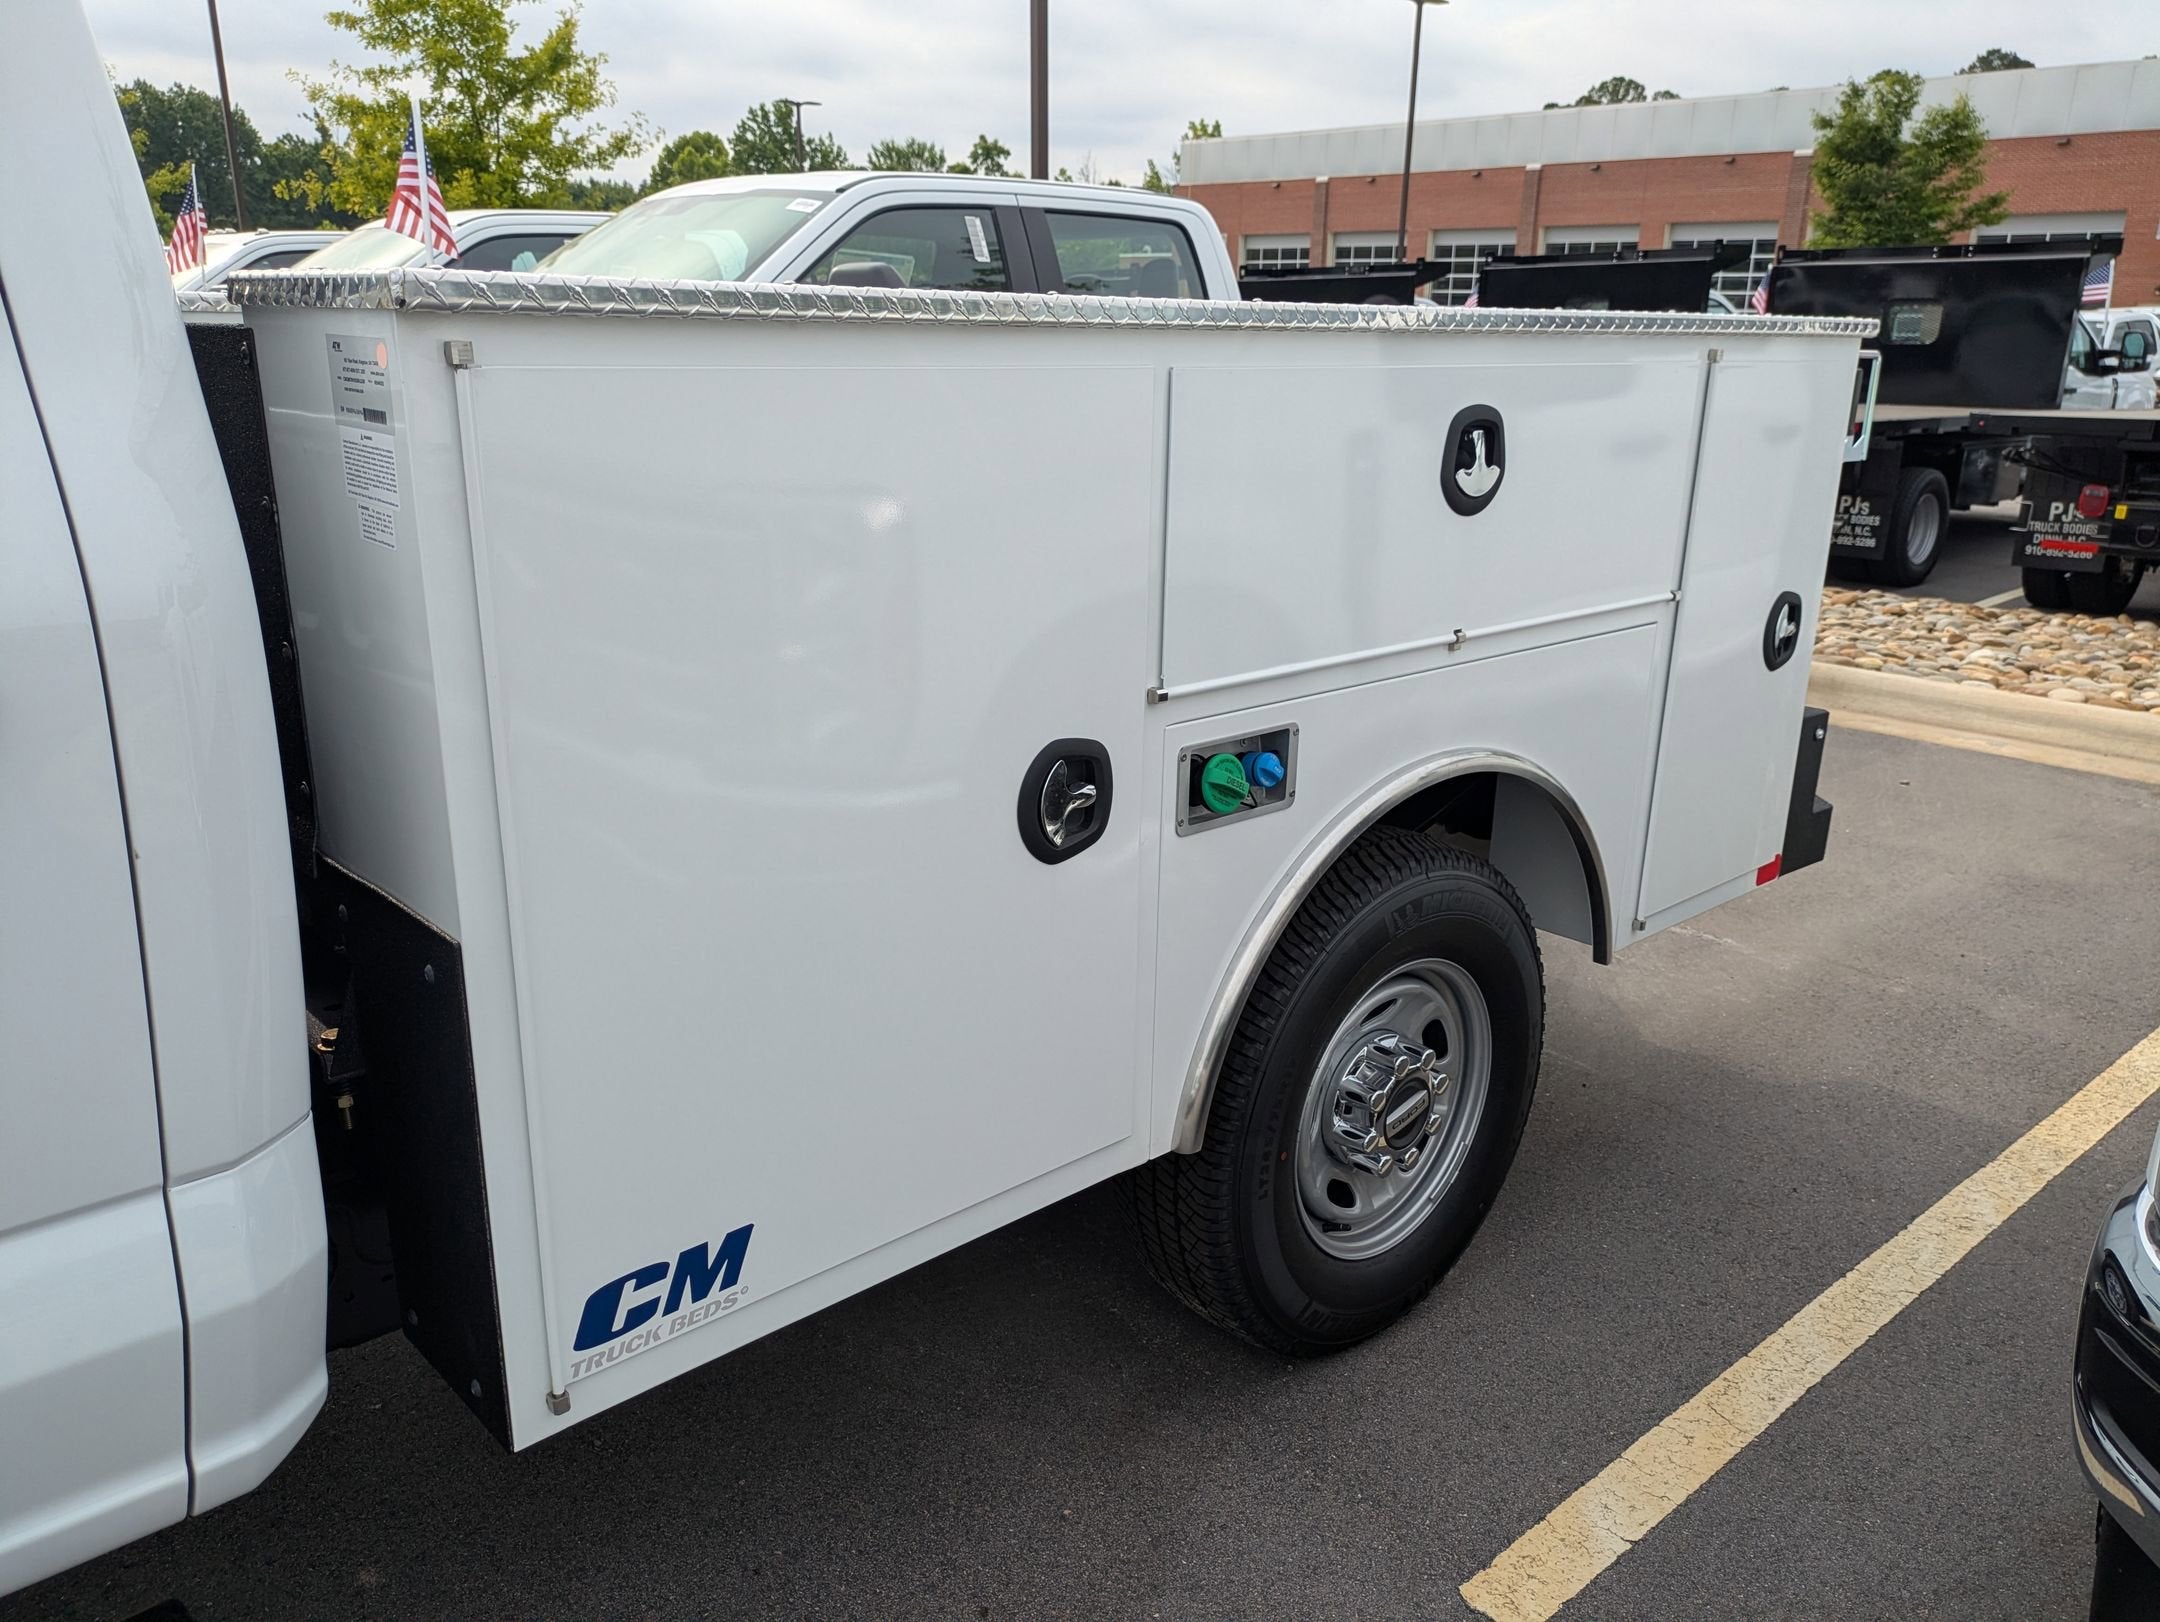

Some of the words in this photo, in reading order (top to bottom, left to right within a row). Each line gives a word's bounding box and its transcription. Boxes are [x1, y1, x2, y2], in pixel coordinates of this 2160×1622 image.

[2029, 520, 2061, 533] TRUCK
[2062, 523, 2098, 535] BODIES
[1226, 776, 1247, 792] DIESEL
[1391, 1098, 1426, 1131] FORD
[572, 1223, 755, 1352] CM
[570, 1323, 664, 1380] TRUCK
